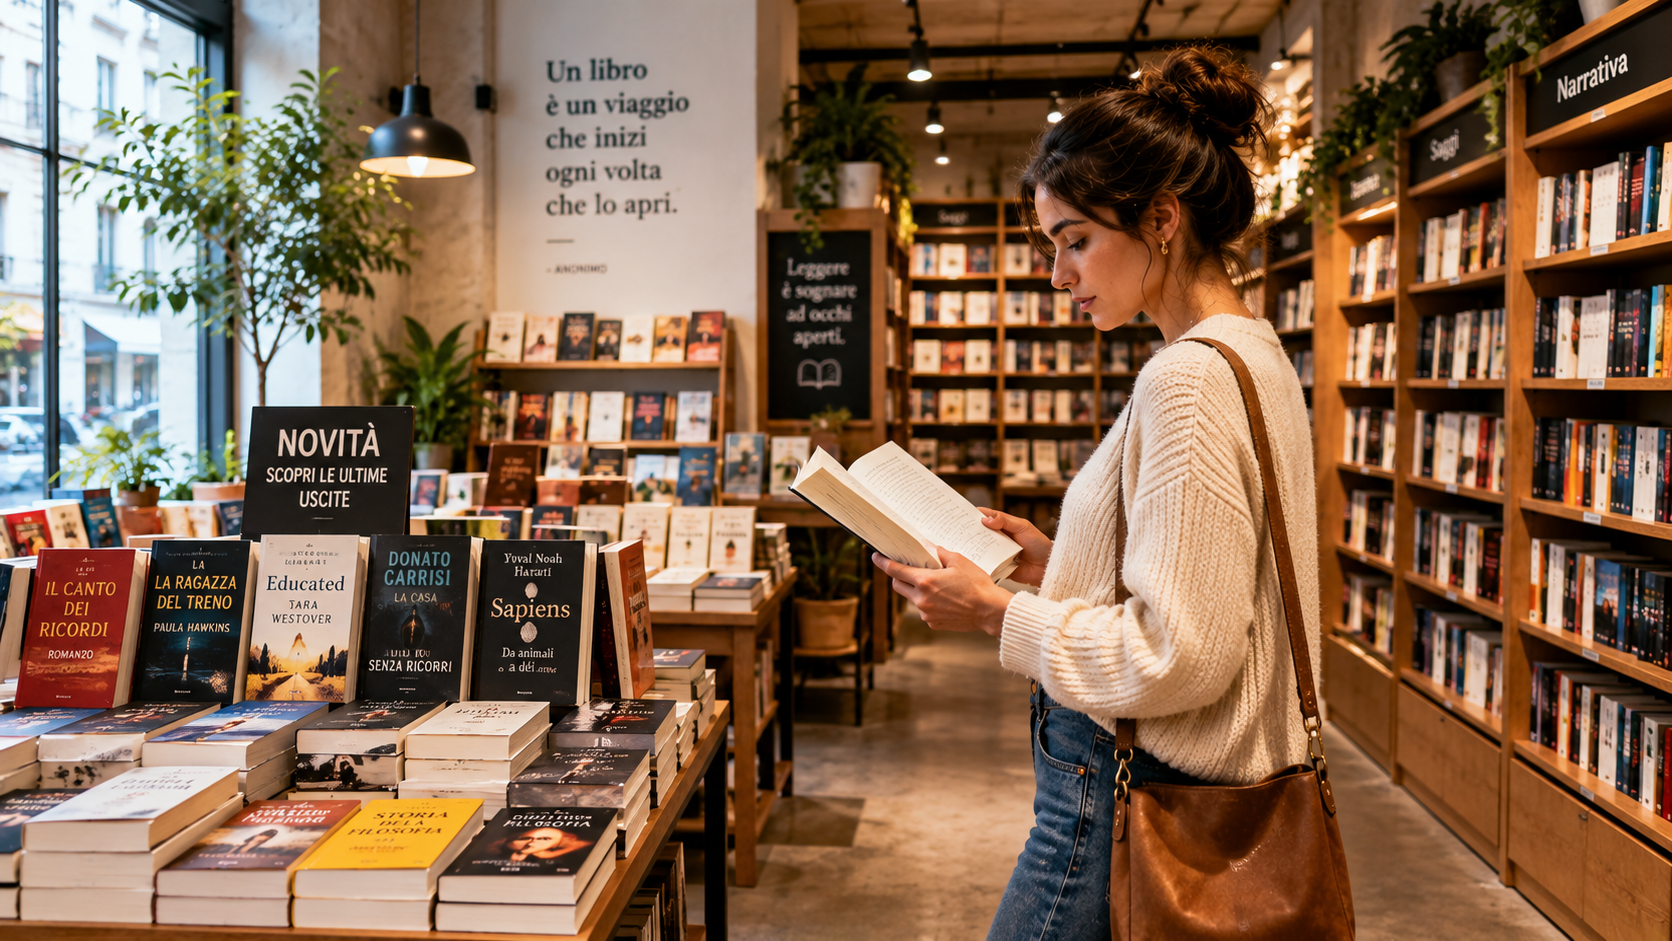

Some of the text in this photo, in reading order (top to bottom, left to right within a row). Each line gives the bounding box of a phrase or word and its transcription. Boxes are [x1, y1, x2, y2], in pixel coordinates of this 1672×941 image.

[546, 58, 648, 83] Un libro
[1556, 53, 1628, 103] Narrativa
[546, 90, 690, 120] è un viaggio
[546, 125, 647, 150] che inizi
[546, 158, 662, 188] ogni volta
[546, 192, 678, 221] che lo apri.
[787, 257, 850, 281] Leggere
[781, 281, 858, 303] è sognare
[785, 304, 853, 322] ad occhi
[793, 327, 846, 349] aperti.
[277, 422, 381, 457] NOVITÀ
[266, 467, 388, 483] SCOPRI LE ULTIME
[299, 490, 351, 508] USCITE
[192, 560, 205, 570] LA
[388, 551, 451, 567] DONATO
[535, 552, 563, 564] Noah
[154, 575, 237, 590] LA RAGAZZA
[266, 575, 345, 591] Educated
[384, 569, 451, 586] CARRISI
[45, 581, 117, 596] IL CANTO
[156, 595, 233, 610] DEL TRENO
[289, 600, 318, 609] TARA
[394, 592, 438, 603] LA CASA
[63, 601, 90, 616] DEI
[490, 597, 571, 623] Sapiens
[272, 613, 332, 624] WESTOVER
[39, 622, 109, 637] RICORDI
[153, 622, 231, 633] PAULA HAWKINS
[501, 647, 554, 659] Da animali
[347, 827, 442, 835] FILOSOFIA
